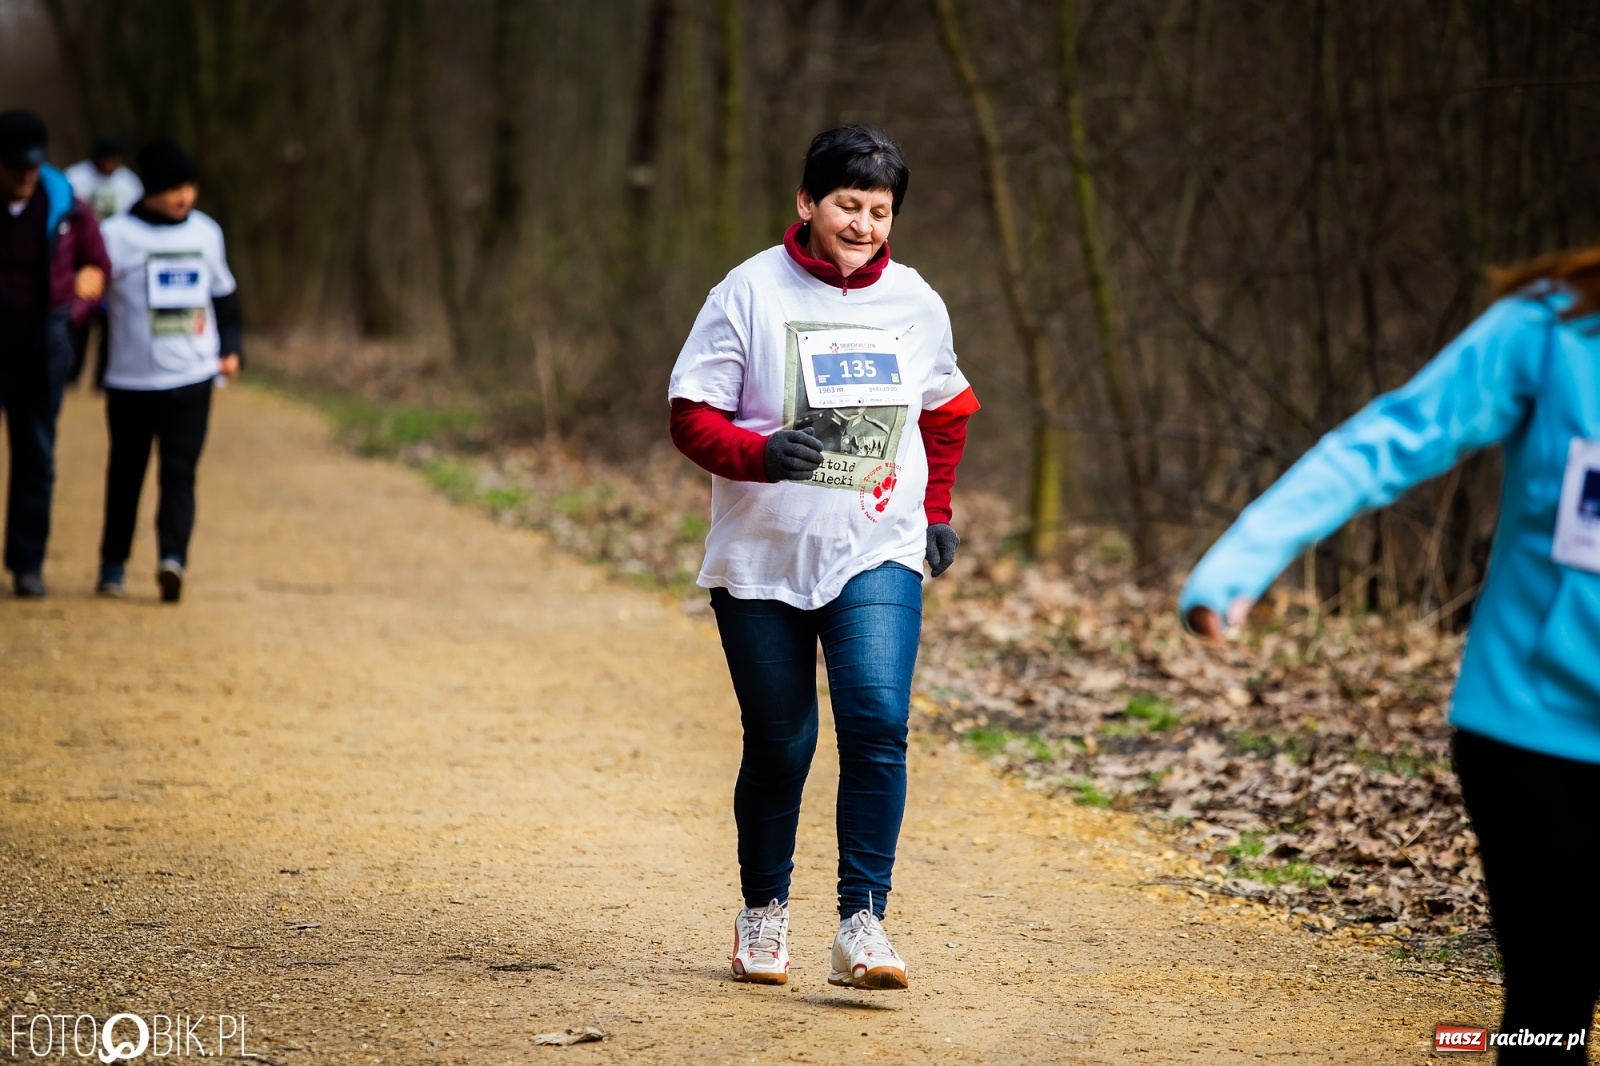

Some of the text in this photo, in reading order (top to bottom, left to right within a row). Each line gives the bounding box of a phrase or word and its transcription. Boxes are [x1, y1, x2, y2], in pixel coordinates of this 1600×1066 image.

[839, 359, 877, 378] 135
[819, 459, 856, 472] itold
[811, 471, 854, 486] ilecki
